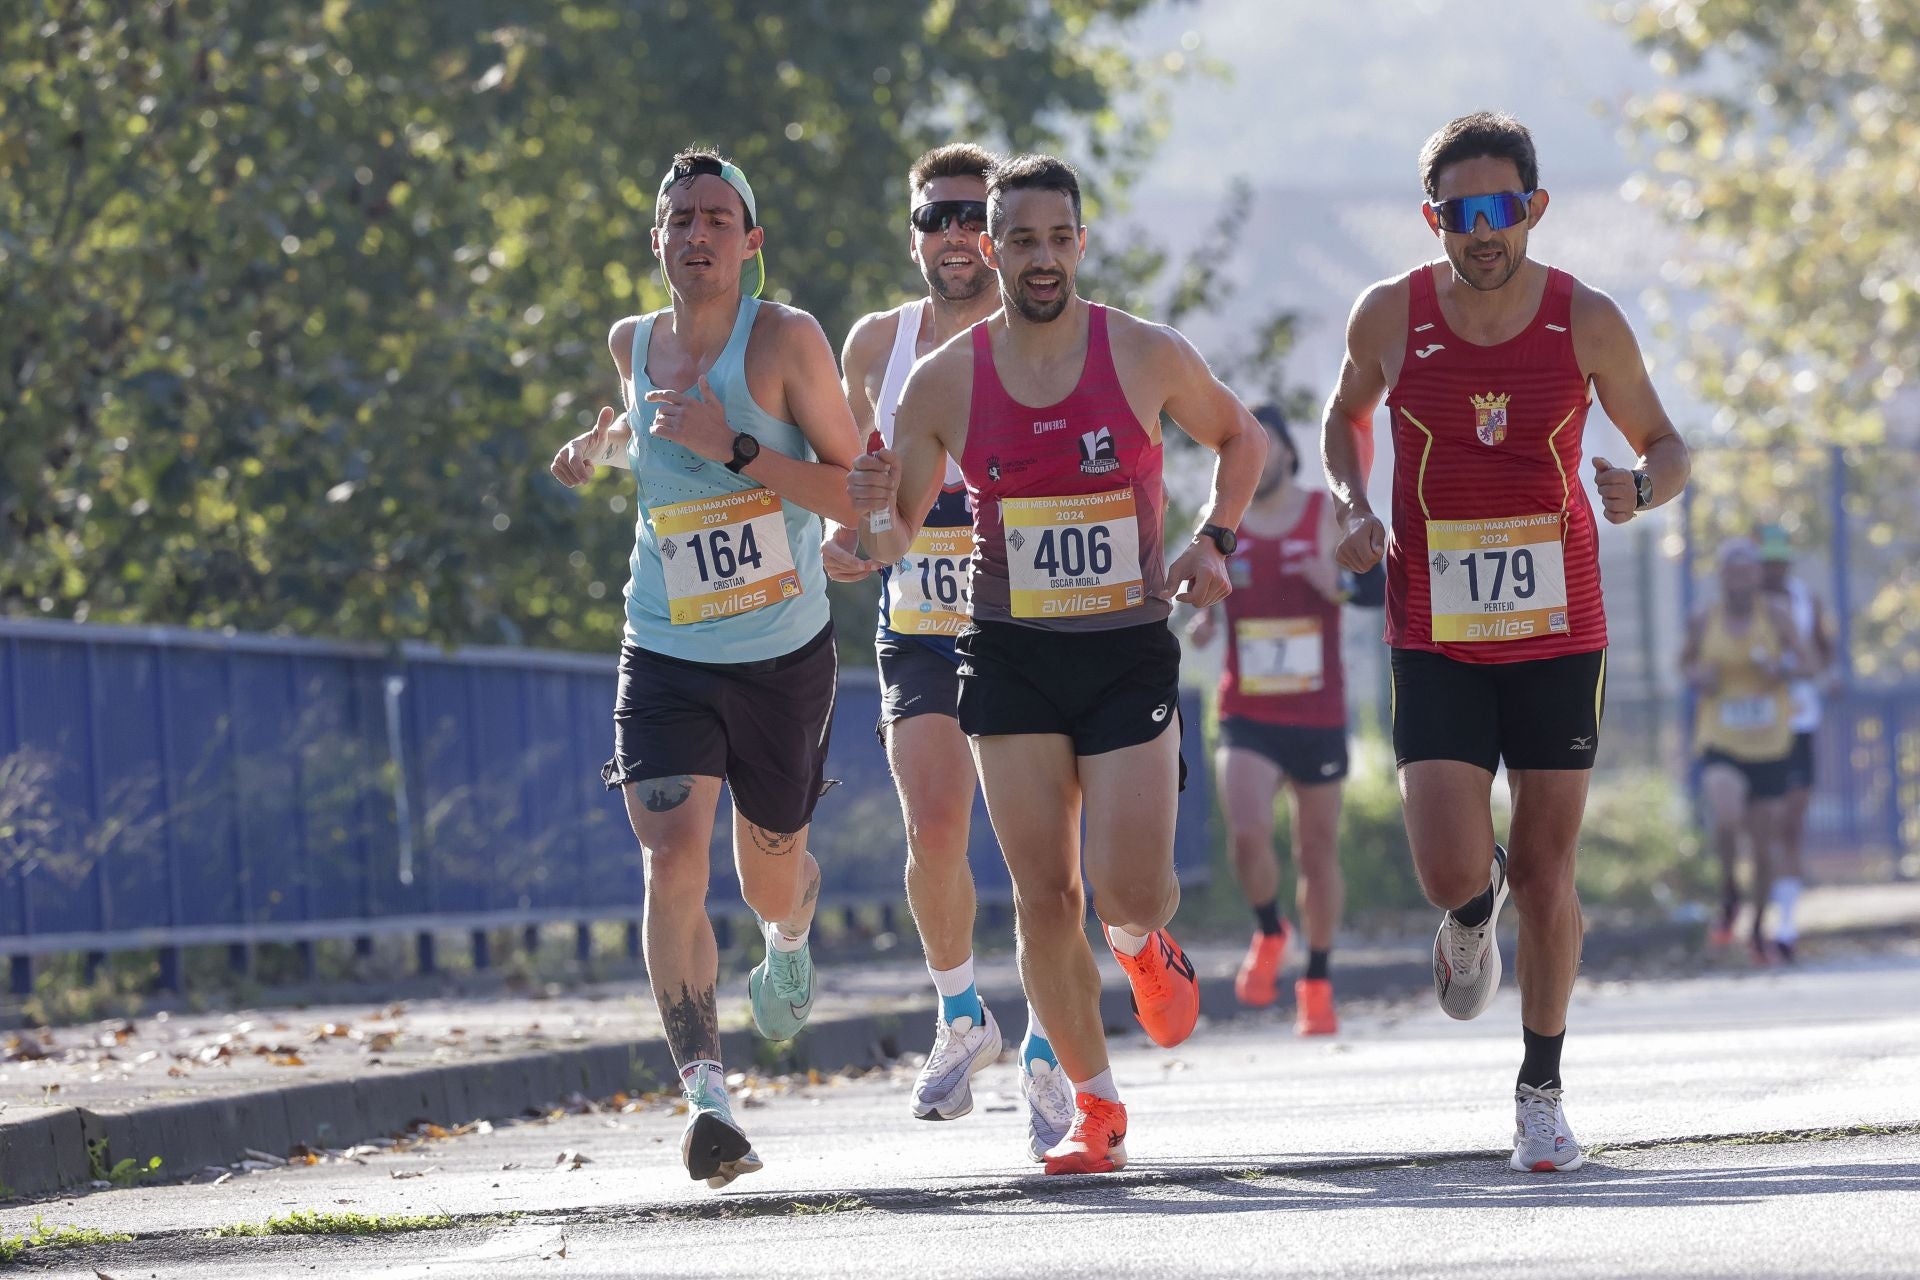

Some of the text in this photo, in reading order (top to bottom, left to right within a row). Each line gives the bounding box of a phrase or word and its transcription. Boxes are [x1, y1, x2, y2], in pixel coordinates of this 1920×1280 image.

[677, 504, 703, 515] MEDIA
[703, 496, 746, 511] MARATÓN
[1031, 500, 1058, 509] MEDIA
[1059, 494, 1104, 508] MARATÓN
[1104, 490, 1132, 504] AVILÉS
[701, 511, 729, 524] 2024
[1056, 511, 1085, 521] 2024
[1455, 522, 1482, 532] MEDIA
[1483, 518, 1528, 531] MARATÓN
[1529, 513, 1558, 526] AVILÉS
[930, 542, 955, 551] 2024
[1480, 534, 1509, 544] 2024
[686, 523, 762, 582] 164
[1033, 525, 1112, 578] 406
[713, 576, 746, 591] CRISTIAN
[1050, 576, 1101, 588] OSCAR MORLA
[1459, 548, 1536, 602] 179
[701, 590, 767, 618] avilés
[1042, 594, 1112, 613] avilés
[1484, 602, 1515, 613] PERTEJO
[1466, 618, 1535, 638] avilés
